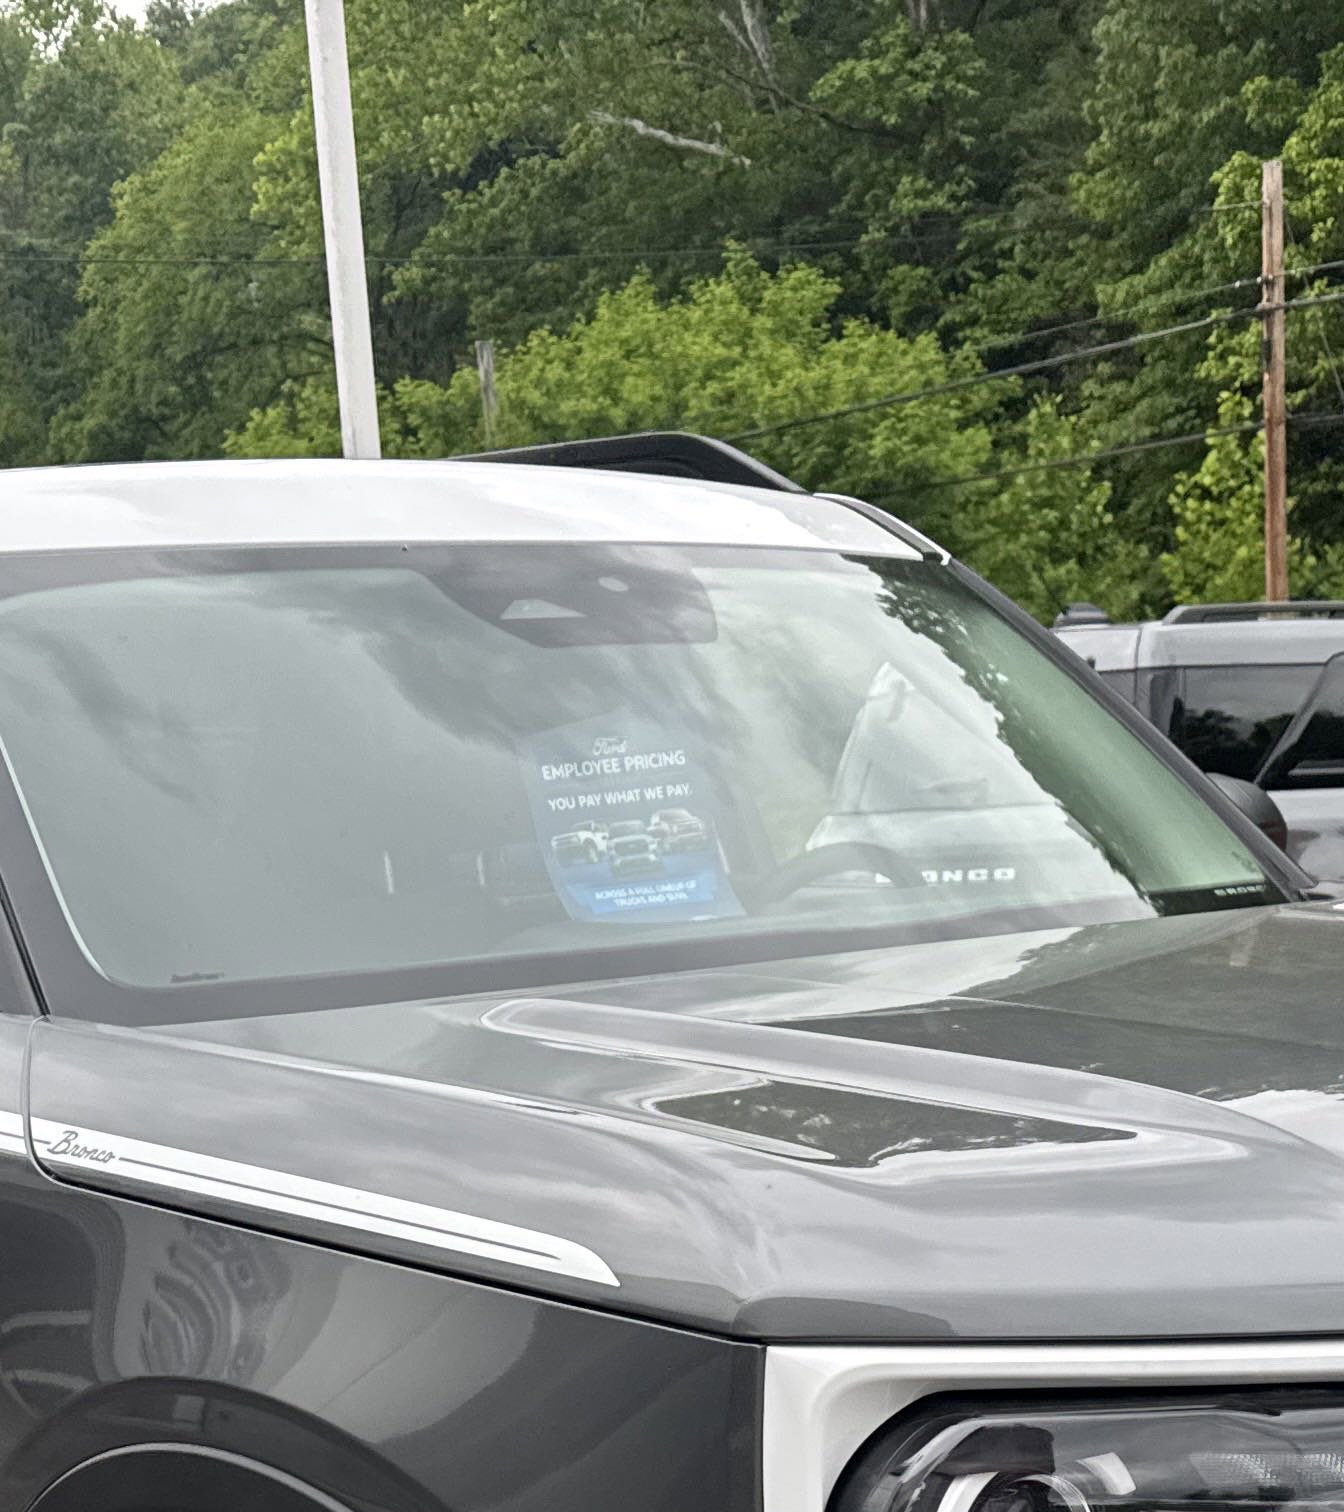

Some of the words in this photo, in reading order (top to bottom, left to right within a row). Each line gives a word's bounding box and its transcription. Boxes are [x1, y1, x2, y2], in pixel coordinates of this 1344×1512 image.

[593, 736, 629, 756] Ford
[541, 757, 621, 781] EMPLOYEE
[623, 750, 686, 772] PRICING
[548, 797, 576, 811] YOU
[578, 793, 602, 808] PAY
[604, 788, 641, 805] WHAT
[643, 785, 664, 800] WE
[47, 1130, 115, 1163] Bronco
